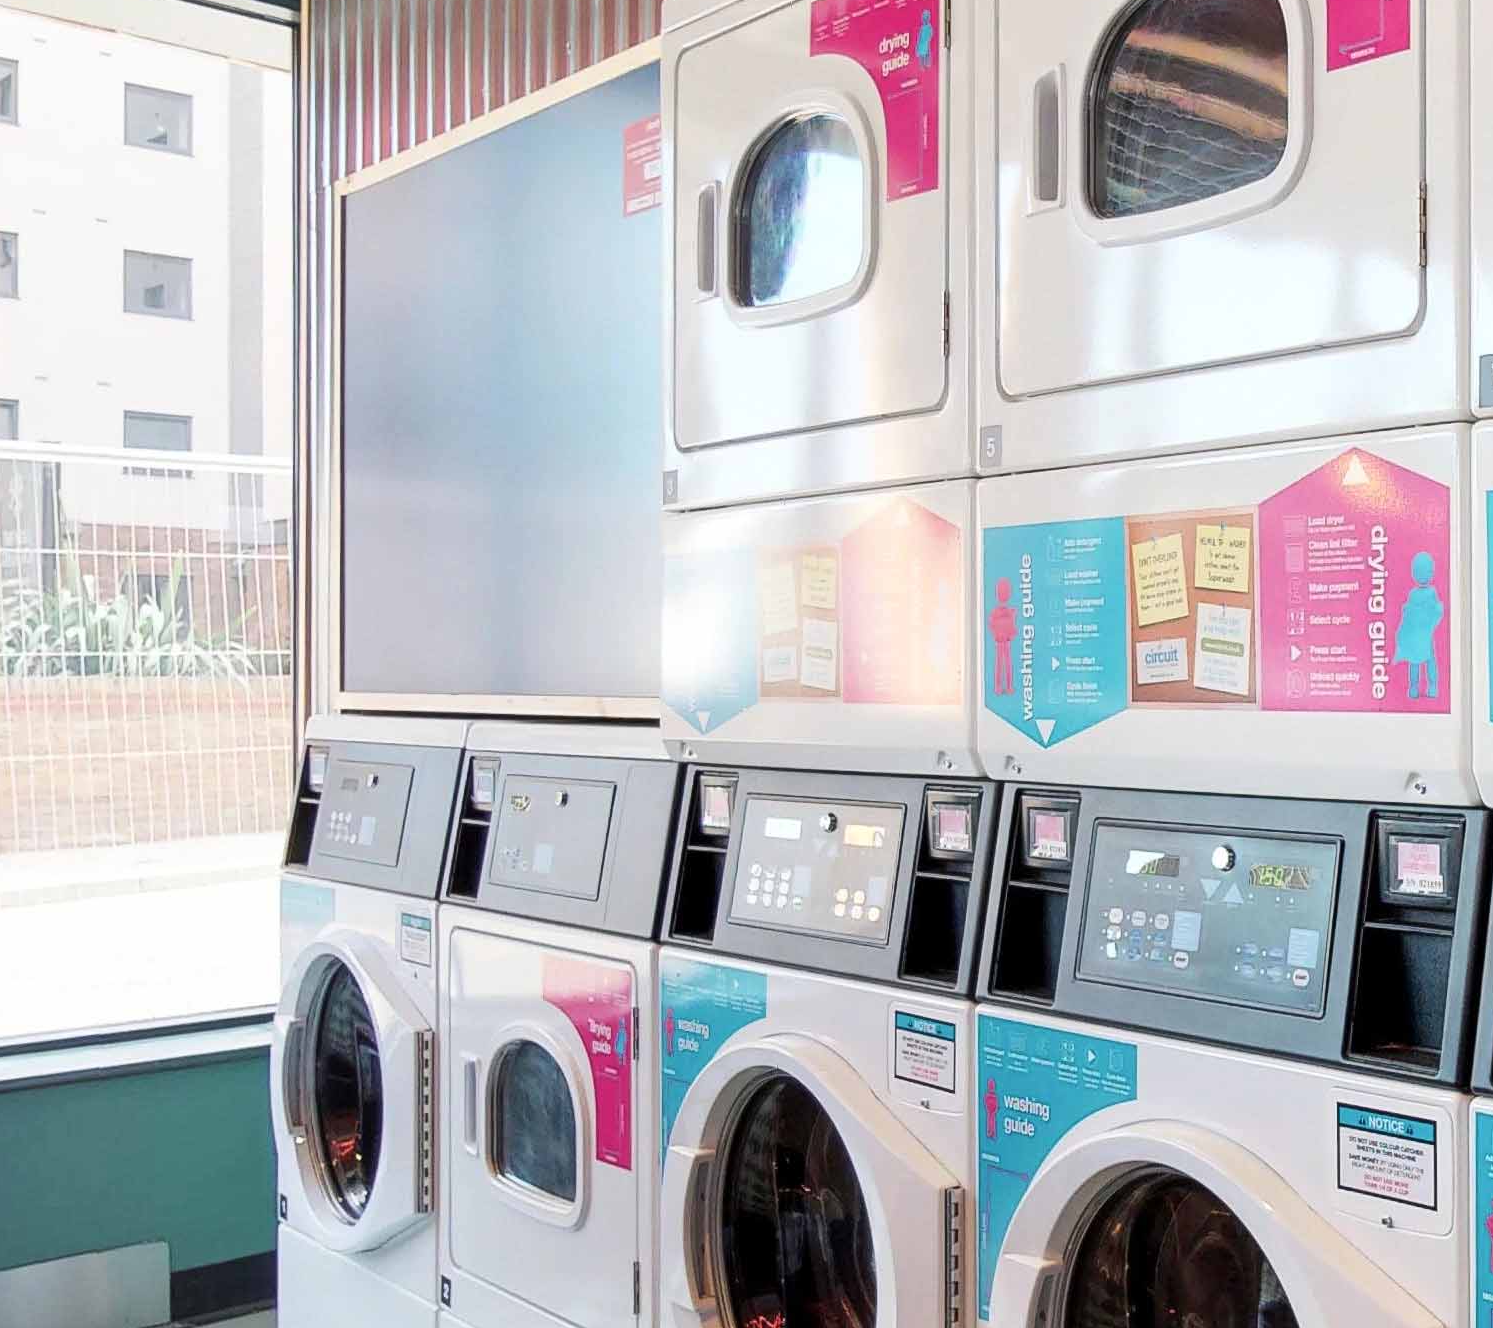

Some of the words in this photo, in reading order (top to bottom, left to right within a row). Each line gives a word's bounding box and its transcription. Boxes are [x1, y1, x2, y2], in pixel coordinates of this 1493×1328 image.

[878, 32, 910, 54] drying
[882, 51, 910, 77] guide
[986, 437, 995, 457] 5
[1368, 524, 1388, 613] drying
[1021, 553, 1036, 622] guide
[1144, 646, 1180, 667] circuit
[1368, 621, 1390, 700] guide
[1022, 627, 1035, 722] washing
[677, 1018, 710, 1040] washing
[678, 1036, 700, 1053] guide
[1004, 1093, 1051, 1122] washing
[1004, 1116, 1035, 1137] guide
[1368, 1116, 1404, 1132] NOTICE
[443, 1282, 450, 1300] 2
